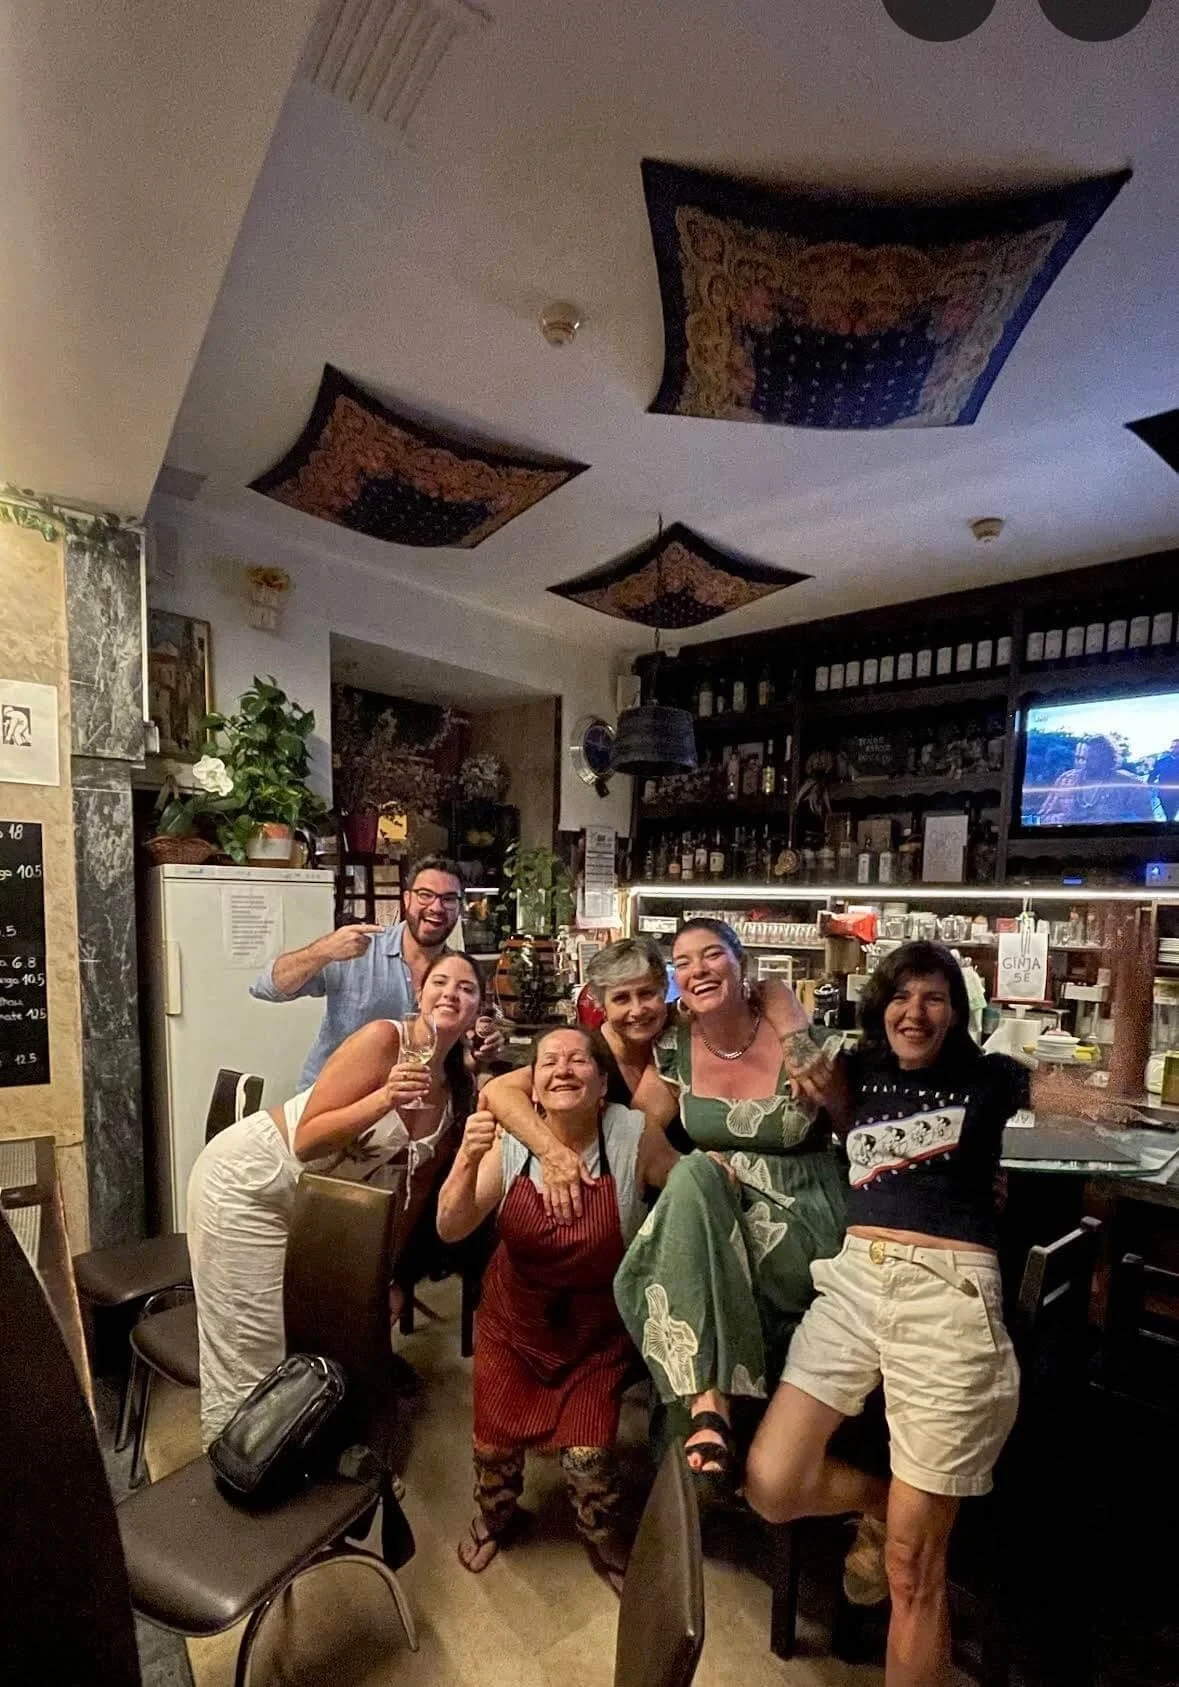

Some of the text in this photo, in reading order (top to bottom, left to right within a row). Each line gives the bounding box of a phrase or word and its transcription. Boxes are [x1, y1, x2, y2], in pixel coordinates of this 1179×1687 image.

[8, 823, 24, 840] 18
[11, 956, 37, 969] 6.8
[1002, 957, 1041, 972] GINJA
[22, 973, 46, 988] 10.5
